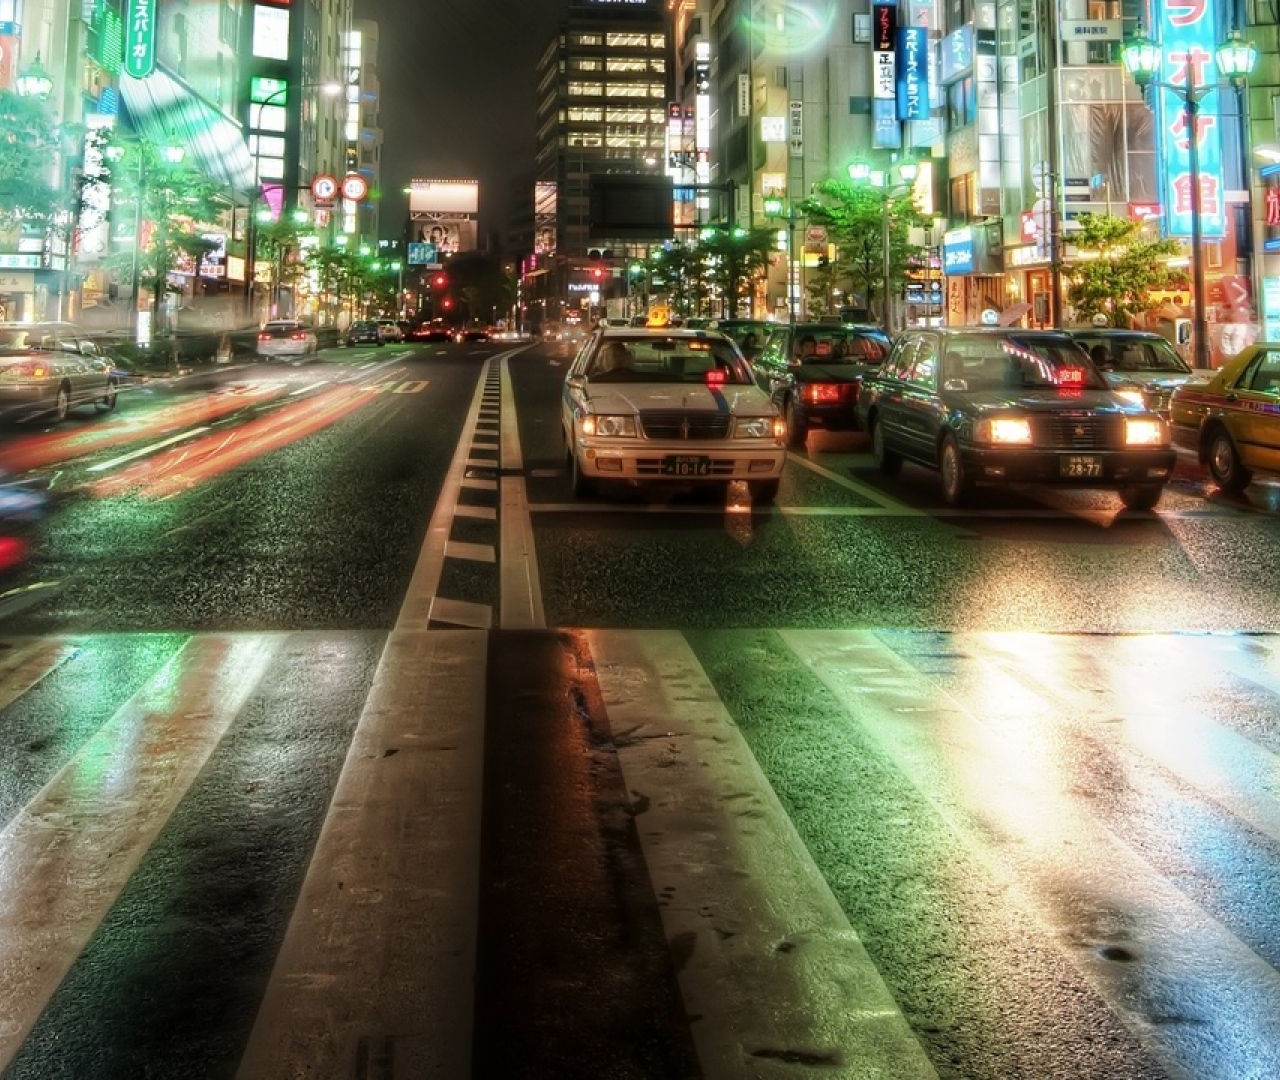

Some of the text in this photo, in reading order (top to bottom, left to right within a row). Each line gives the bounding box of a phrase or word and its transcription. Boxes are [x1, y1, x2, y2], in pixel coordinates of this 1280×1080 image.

[906, 29, 920, 118] スペーストラスト
